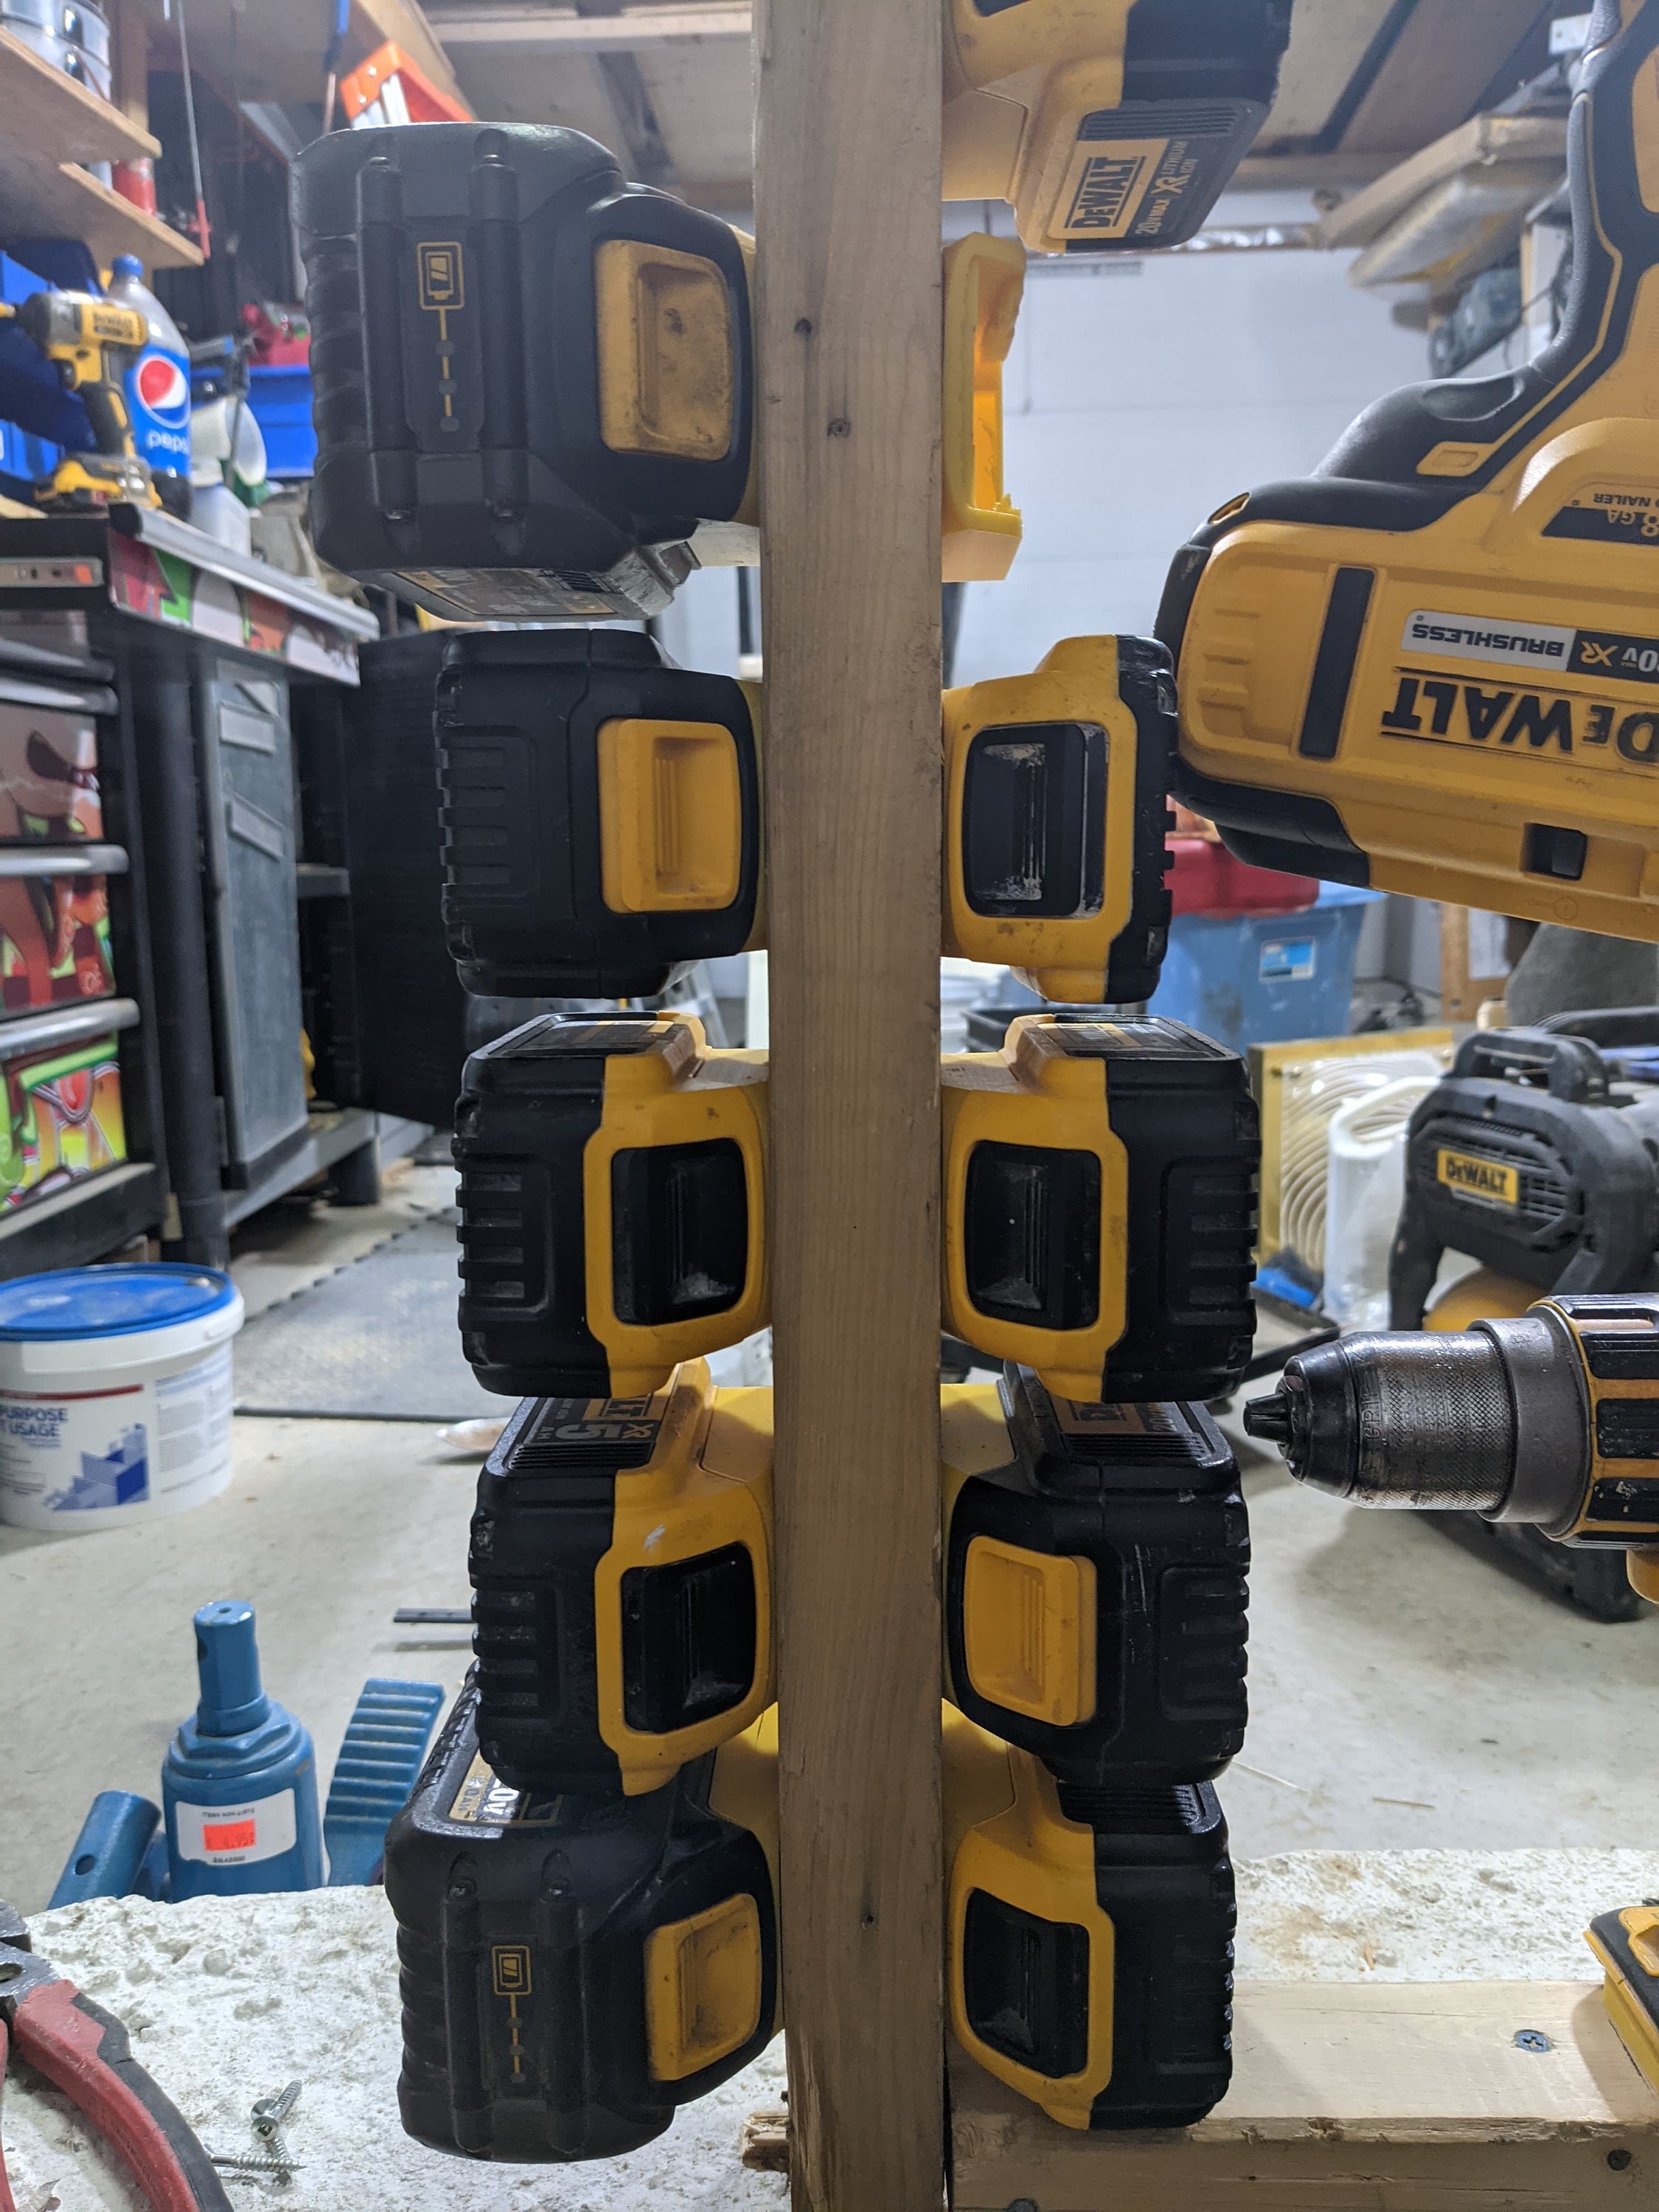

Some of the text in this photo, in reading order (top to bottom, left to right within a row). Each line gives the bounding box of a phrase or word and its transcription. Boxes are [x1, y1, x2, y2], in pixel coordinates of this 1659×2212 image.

[1151, 175, 1189, 195] XR
[148, 431, 189, 453] peps
[1593, 493, 1651, 507] NAILER
[1606, 509, 1635, 525] GA
[1411, 624, 1565, 657] BRUSHLESS
[1579, 641, 1619, 667] XR
[1381, 678, 1659, 763] DEWALT
[9, 1422, 60, 1437] USAGE
[554, 1424, 622, 1440] 5
[622, 1422, 655, 1439] XR
